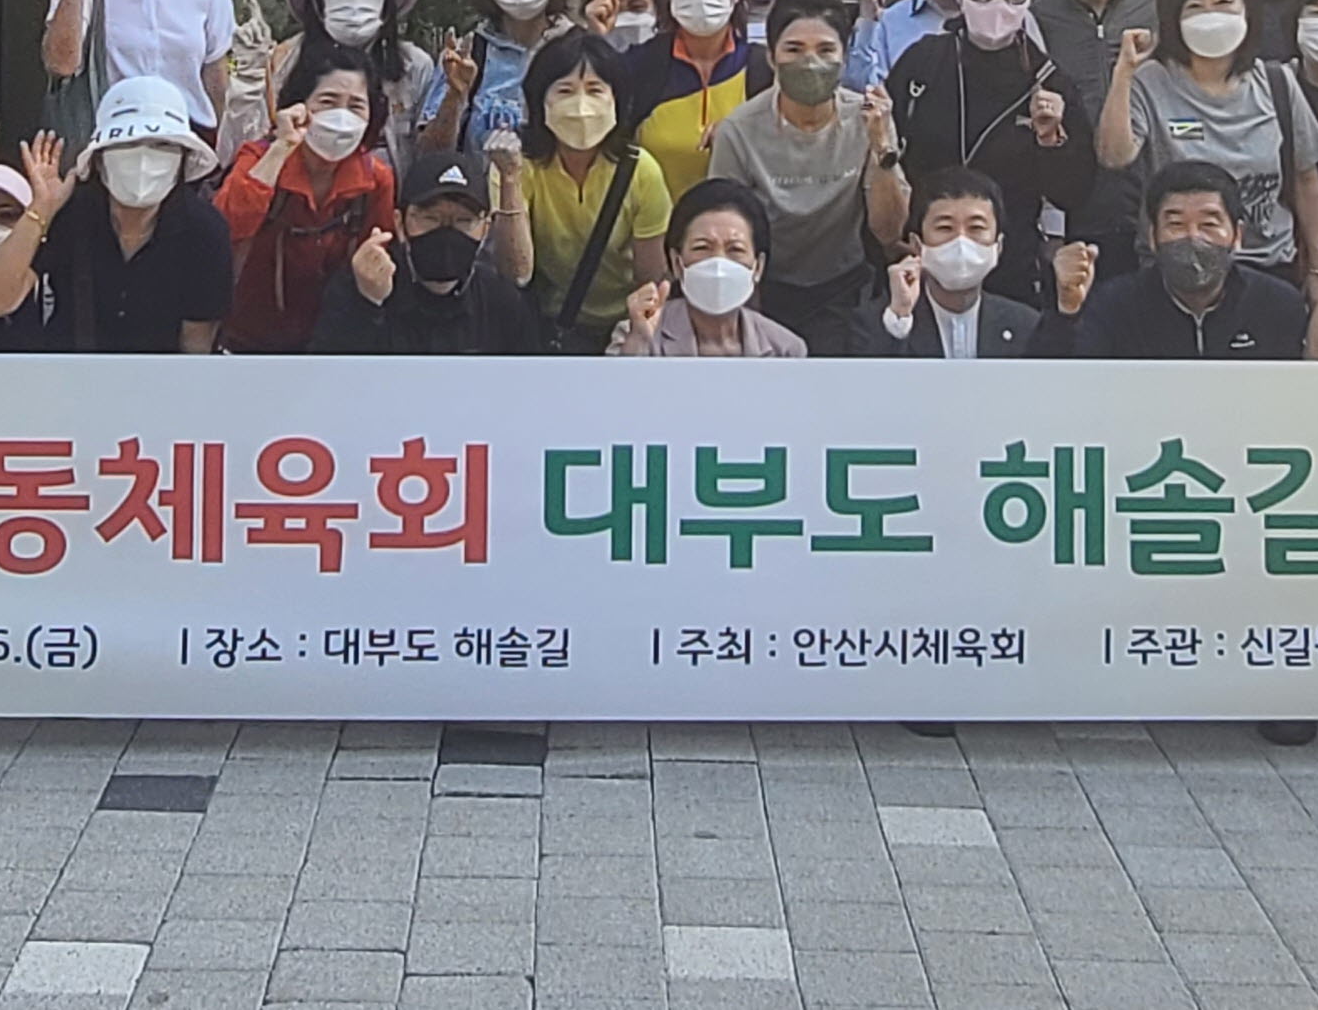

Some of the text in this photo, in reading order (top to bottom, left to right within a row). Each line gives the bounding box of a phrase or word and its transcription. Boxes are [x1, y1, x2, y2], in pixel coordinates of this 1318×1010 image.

[543, 443, 934, 570] 대부도
[204, 627, 283, 668] 장소
[323, 627, 440, 668] 대부도
[453, 626, 570, 668] 해솔길
[676, 626, 752, 667] 주최
[793, 626, 1025, 668] 안산시체육회
[1126, 627, 1203, 667] 주관
